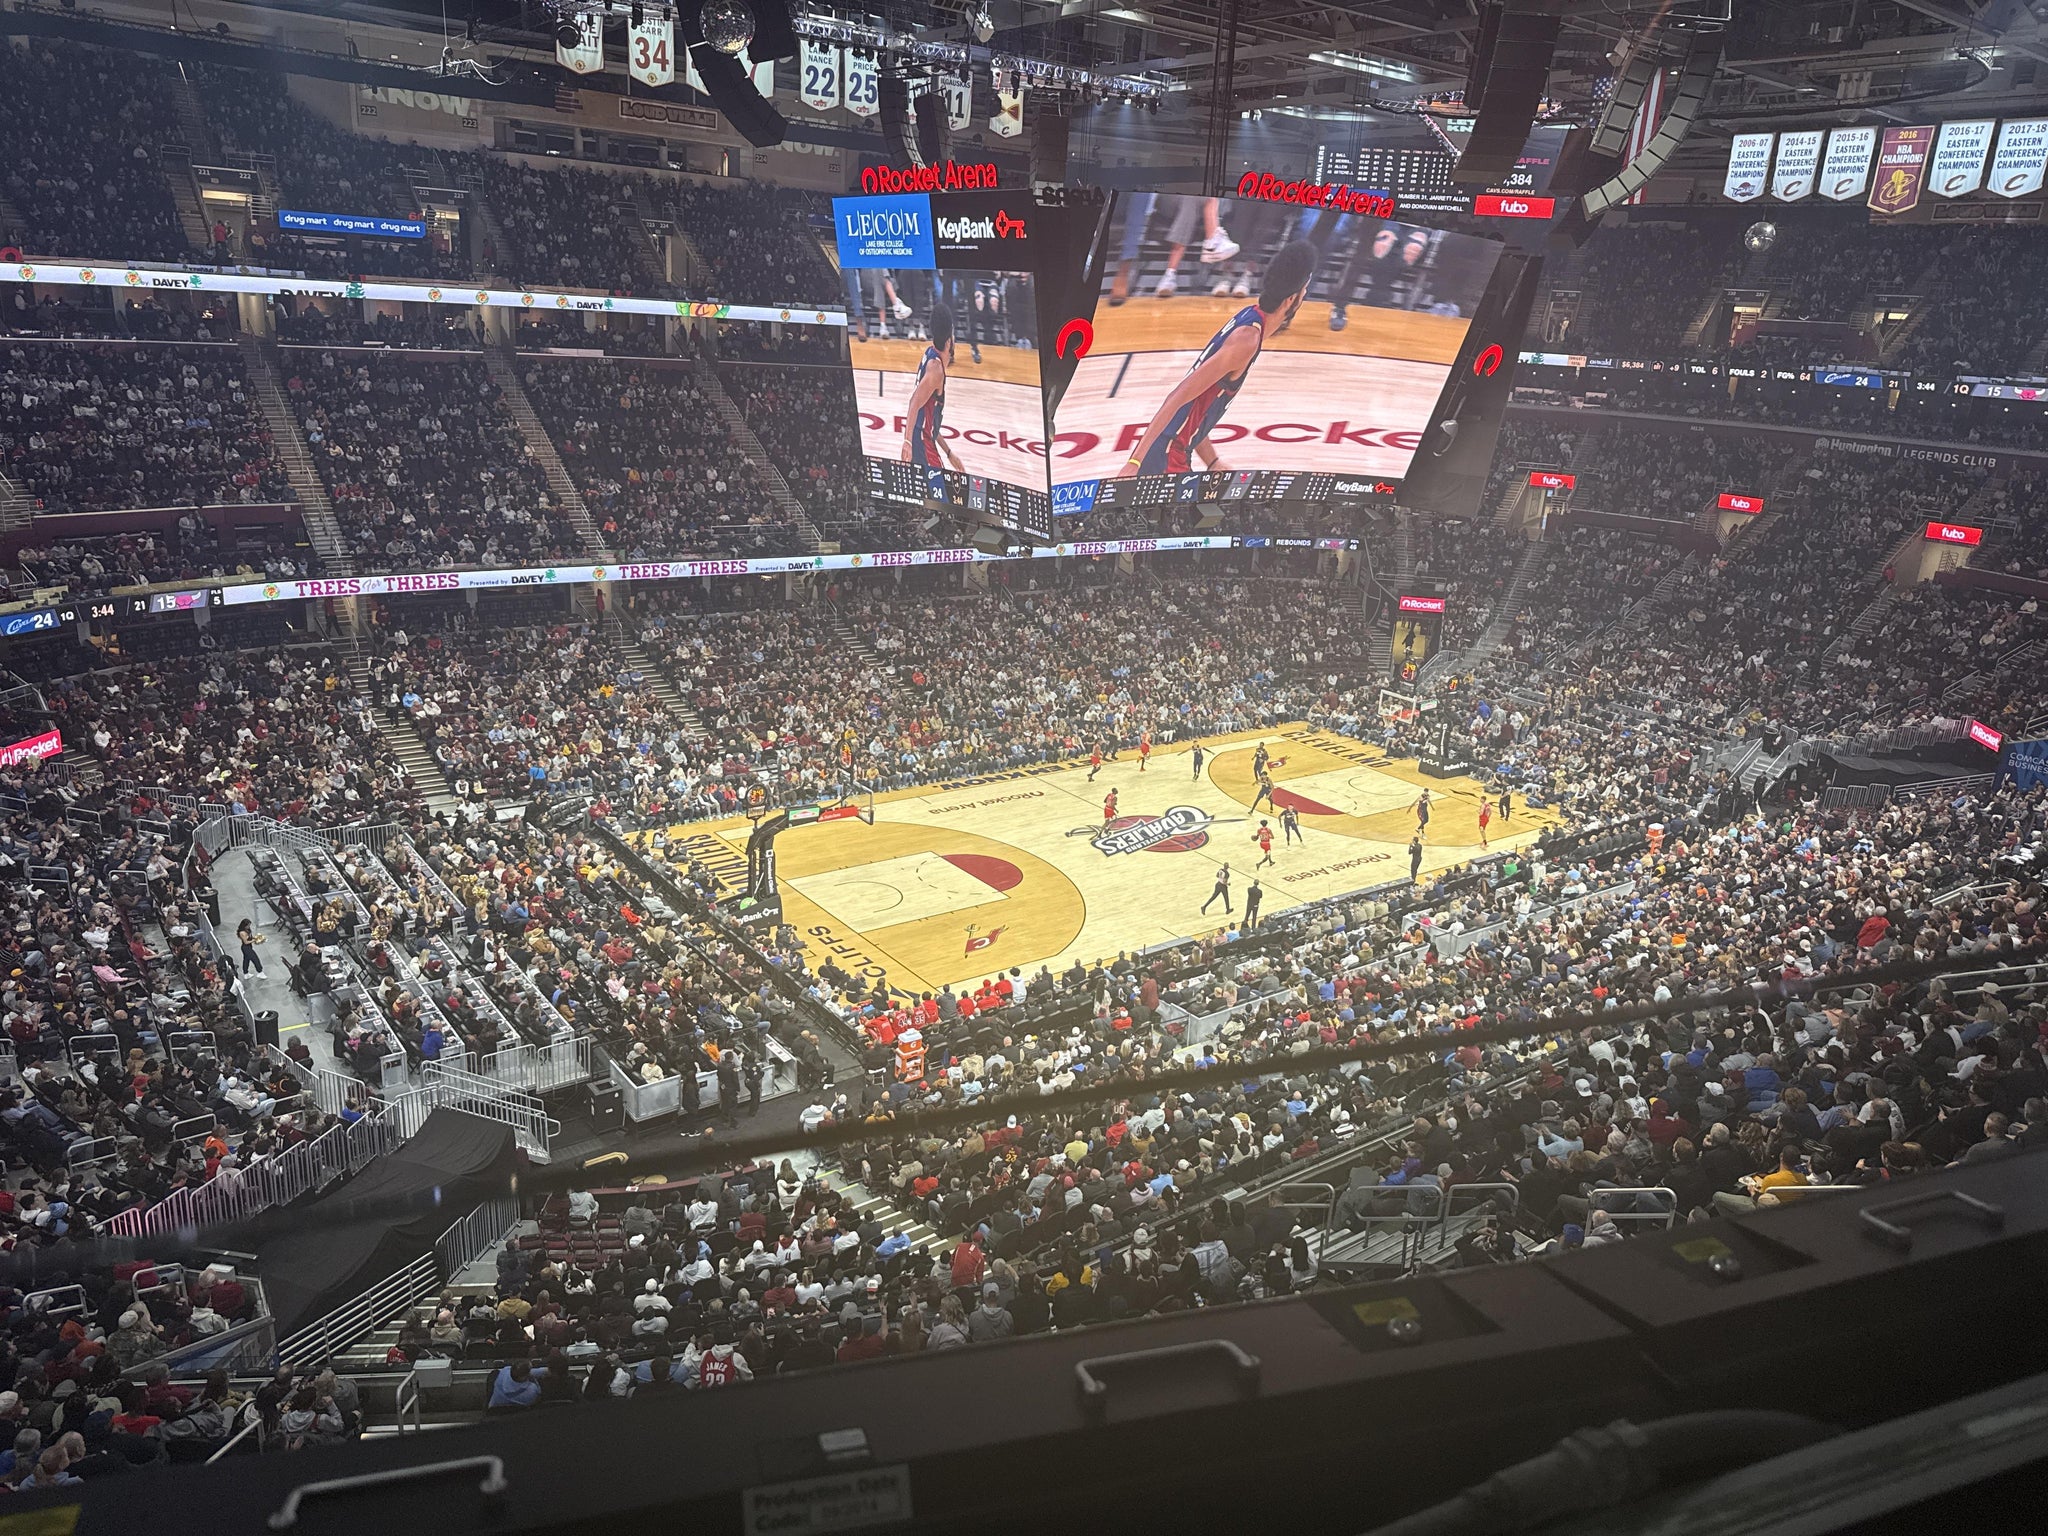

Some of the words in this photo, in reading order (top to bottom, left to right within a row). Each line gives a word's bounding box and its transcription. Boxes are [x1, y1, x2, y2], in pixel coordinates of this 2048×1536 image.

[640, 26, 662, 36] CARR
[635, 37, 670, 72] 34
[808, 54, 833, 65] NANCE
[853, 61, 874, 71] PRICE
[805, 65, 835, 98] 22
[849, 71, 878, 104] 25
[361, 106, 377, 115] 222
[463, 118, 477, 128] 223
[1949, 126, 1985, 135] 2016-17
[2008, 124, 2048, 134] 2017-18
[1836, 132, 1869, 142] 2015-16
[1898, 131, 1917, 139] 2016
[1739, 139, 1768, 148] 2006-07
[1786, 137, 1816, 146] 2014-15
[1947, 139, 1980, 148] EASTERN
[2007, 137, 2042, 147] EASTERN
[1785, 148, 1812, 157] EASTERN
[1835, 145, 1865, 153] EASTERN
[1897, 145, 1912, 154] NBA
[1997, 148, 2047, 158] CONFERENCE
[1737, 151, 1764, 159] EASTERN
[1828, 154, 1869, 164] CONFERENCE
[1882, 154, 1923, 164] CHAMPIONS
[1938, 150, 1984, 159] CONFERENCE
[1315, 145, 1326, 186] CAVALIERS
[1731, 159, 1768, 168] CONFERENCE
[1778, 158, 1816, 167] CONFERENCE
[1938, 160, 1980, 170] CHAMPIONS
[1997, 159, 2042, 169] CHAMPIONS
[1731, 170, 1764, 178] CHAMPIONS
[1777, 168, 1812, 176] CHAMPIONS
[1827, 165, 1865, 174] CHAMPIONS
[879, 162, 943, 194] Rocket
[944, 159, 998, 190] Arena
[1257, 172, 1331, 207] Rocket
[1328, 183, 1395, 219] Arena
[1500, 200, 1528, 213] fubo
[284, 213, 305, 225] drug
[306, 216, 328, 225] mart
[333, 217, 353, 229] drug
[354, 220, 374, 229] mart
[380, 221, 400, 233] drug
[401, 224, 421, 232] mart
[937, 216, 996, 243] KeyBank
[152, 277, 189, 288] DAVEY
[577, 300, 604, 310] DAVEY
[1691, 365, 1706, 374] TOL
[1711, 366, 1718, 375] 6
[1729, 368, 1755, 377] FOULS
[1760, 370, 1767, 379] 2
[1776, 371, 1795, 380] FG%
[1799, 372, 1811, 381] 64
[1855, 377, 1869, 387] 24
[1888, 380, 1899, 388] 21
[1916, 382, 1935, 391] 3:44
[1953, 384, 1970, 395] 1Q
[1987, 386, 2001, 396] 15
[1831, 438, 1892, 457] Huntington
[1904, 448, 1959, 464] LEGENDS
[1962, 455, 1997, 468] CLUB
[944, 474, 951, 482] 1Q
[960, 475, 967, 485] 21
[1223, 473, 1232, 481] 21
[1230, 488, 1241, 497] 15
[1335, 481, 1374, 494] KeyBank
[933, 487, 943, 499] 24
[1181, 489, 1193, 499] 24
[973, 497, 982, 509] 15
[1730, 498, 1750, 509] fubo
[1941, 527, 1965, 540] fubo
[1073, 542, 1107, 555] TREES
[1118, 539, 1157, 551] THREES
[1264, 538, 1270, 547] 8
[1276, 538, 1312, 547] REBOUNDS
[1319, 539, 1325, 548] 4
[872, 553, 913, 566] TREES
[926, 549, 974, 564] THREES
[619, 564, 670, 579] TREES
[689, 560, 748, 576] THREES
[788, 562, 814, 571] DAVEY
[295, 578, 361, 597] TREES
[383, 573, 460, 592] THREES
[469, 578, 500, 586] Presented
[511, 574, 544, 584] DAVEY
[134, 600, 146, 611] 21
[157, 595, 176, 609] 15
[214, 596, 221, 605] 5
[1411, 600, 1442, 610] Rocket
[92, 603, 115, 618] 3:44
[34, 614, 53, 629] 24
[61, 611, 75, 622] 1Q
[1977, 727, 1999, 747] Rocket
[13, 736, 59, 766] Rocket
[1281, 731, 1393, 768] CLEVELAND
[1444, 763, 1460, 771] KeyBank
[933, 771, 1026, 790] KNOW.
[977, 793, 1032, 809] Rocket
[928, 801, 977, 815] Arena
[1095, 805, 1214, 856] CAVALIERS
[1126, 832, 1168, 853] CLEVELAND
[1327, 856, 1381, 874] Rocket
[1282, 866, 1330, 884] Arena
[808, 925, 887, 978] CLIFFS
[706, 1361, 728, 1372] JAMES
